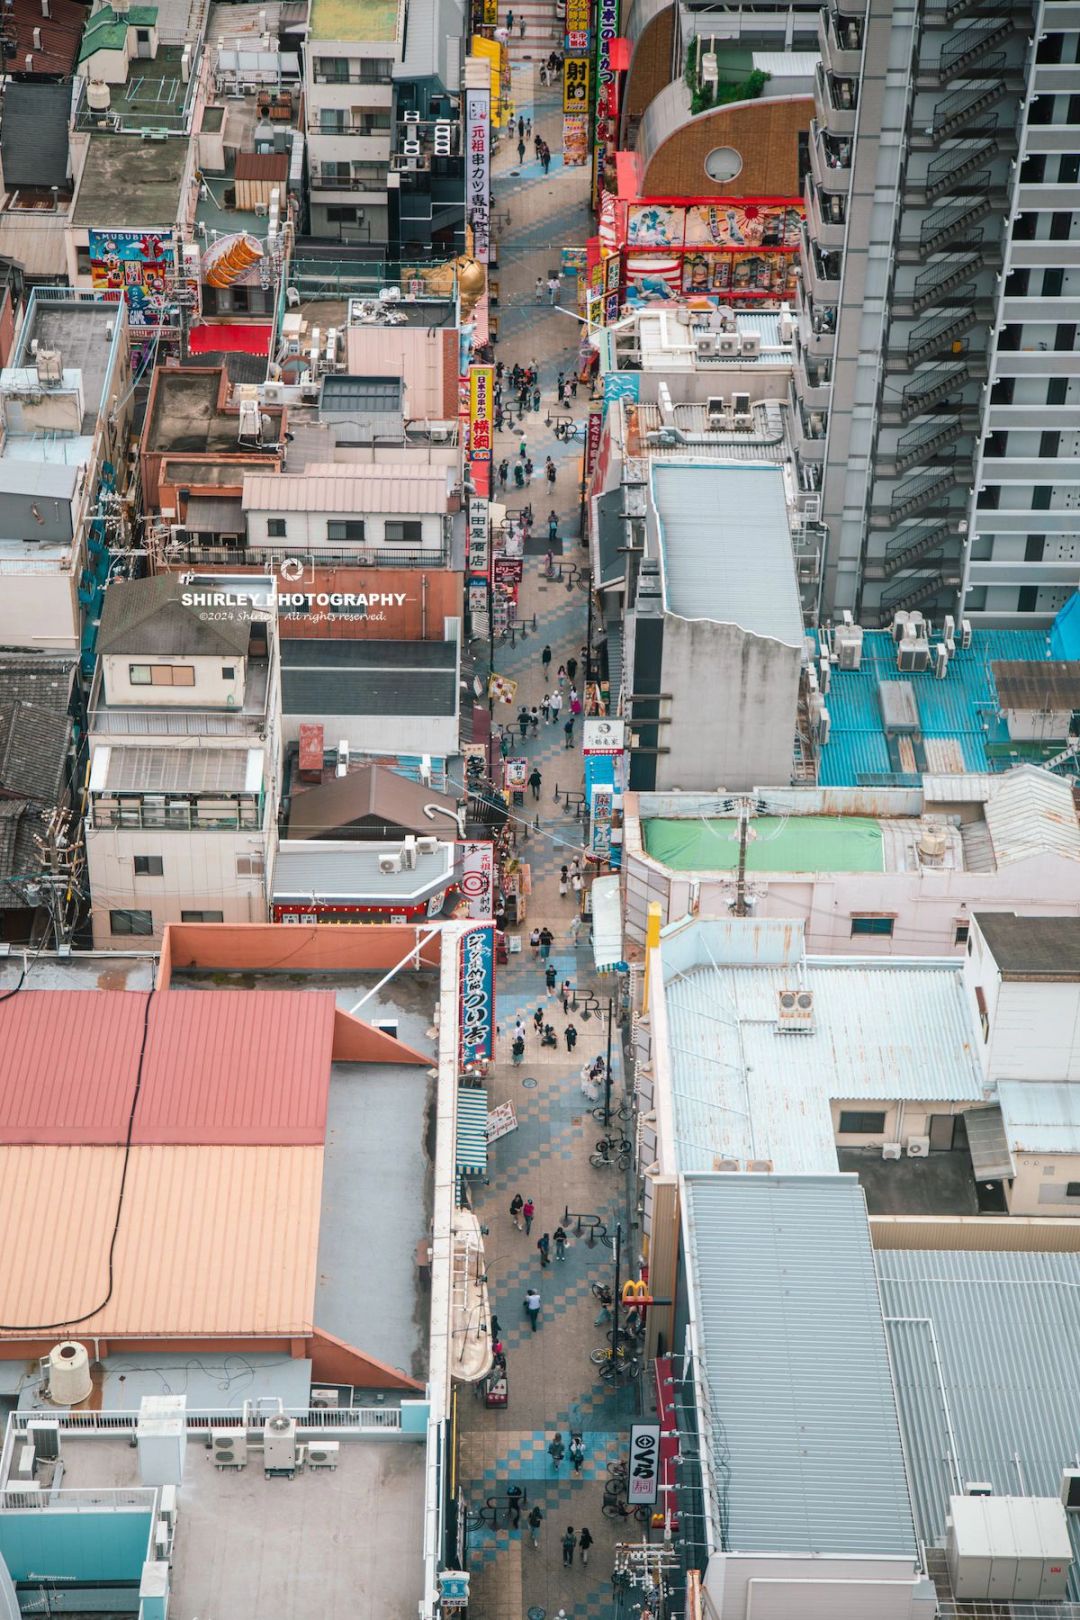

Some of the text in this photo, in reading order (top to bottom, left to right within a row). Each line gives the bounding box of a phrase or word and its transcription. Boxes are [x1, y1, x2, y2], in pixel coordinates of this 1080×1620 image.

[566, 61, 587, 100] 射的
[477, 376, 486, 419] 日本一の串かつ
[473, 419, 490, 450] 横綱
[470, 501, 487, 567] 半田屋酒店
